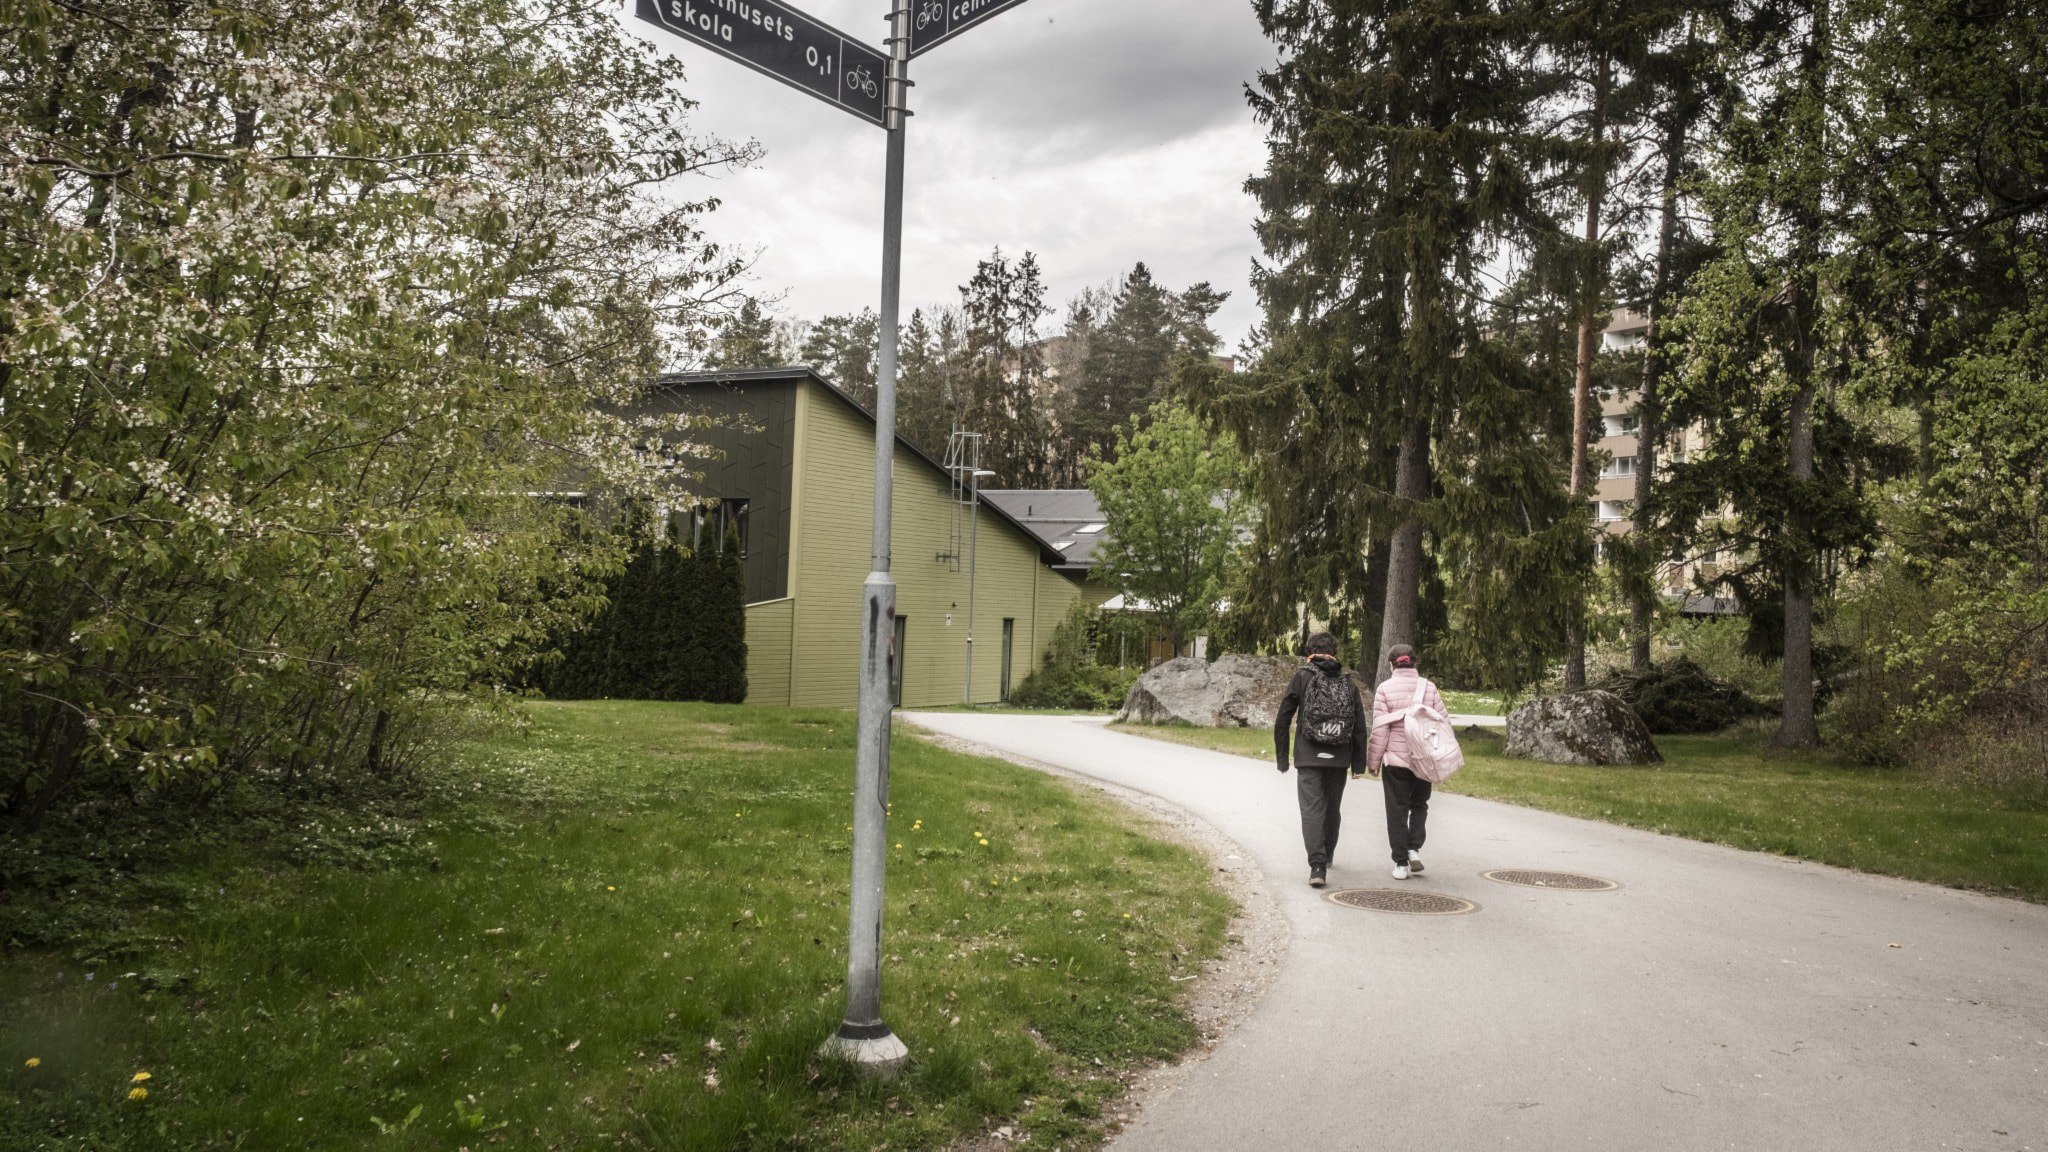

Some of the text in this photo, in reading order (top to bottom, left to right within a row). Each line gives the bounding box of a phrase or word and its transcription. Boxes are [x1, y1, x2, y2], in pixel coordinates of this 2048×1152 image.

[671, 0, 733, 42] skola
[710, 0, 794, 41] husets
[952, 0, 990, 21] cen
[806, 45, 832, 76] 0,1
